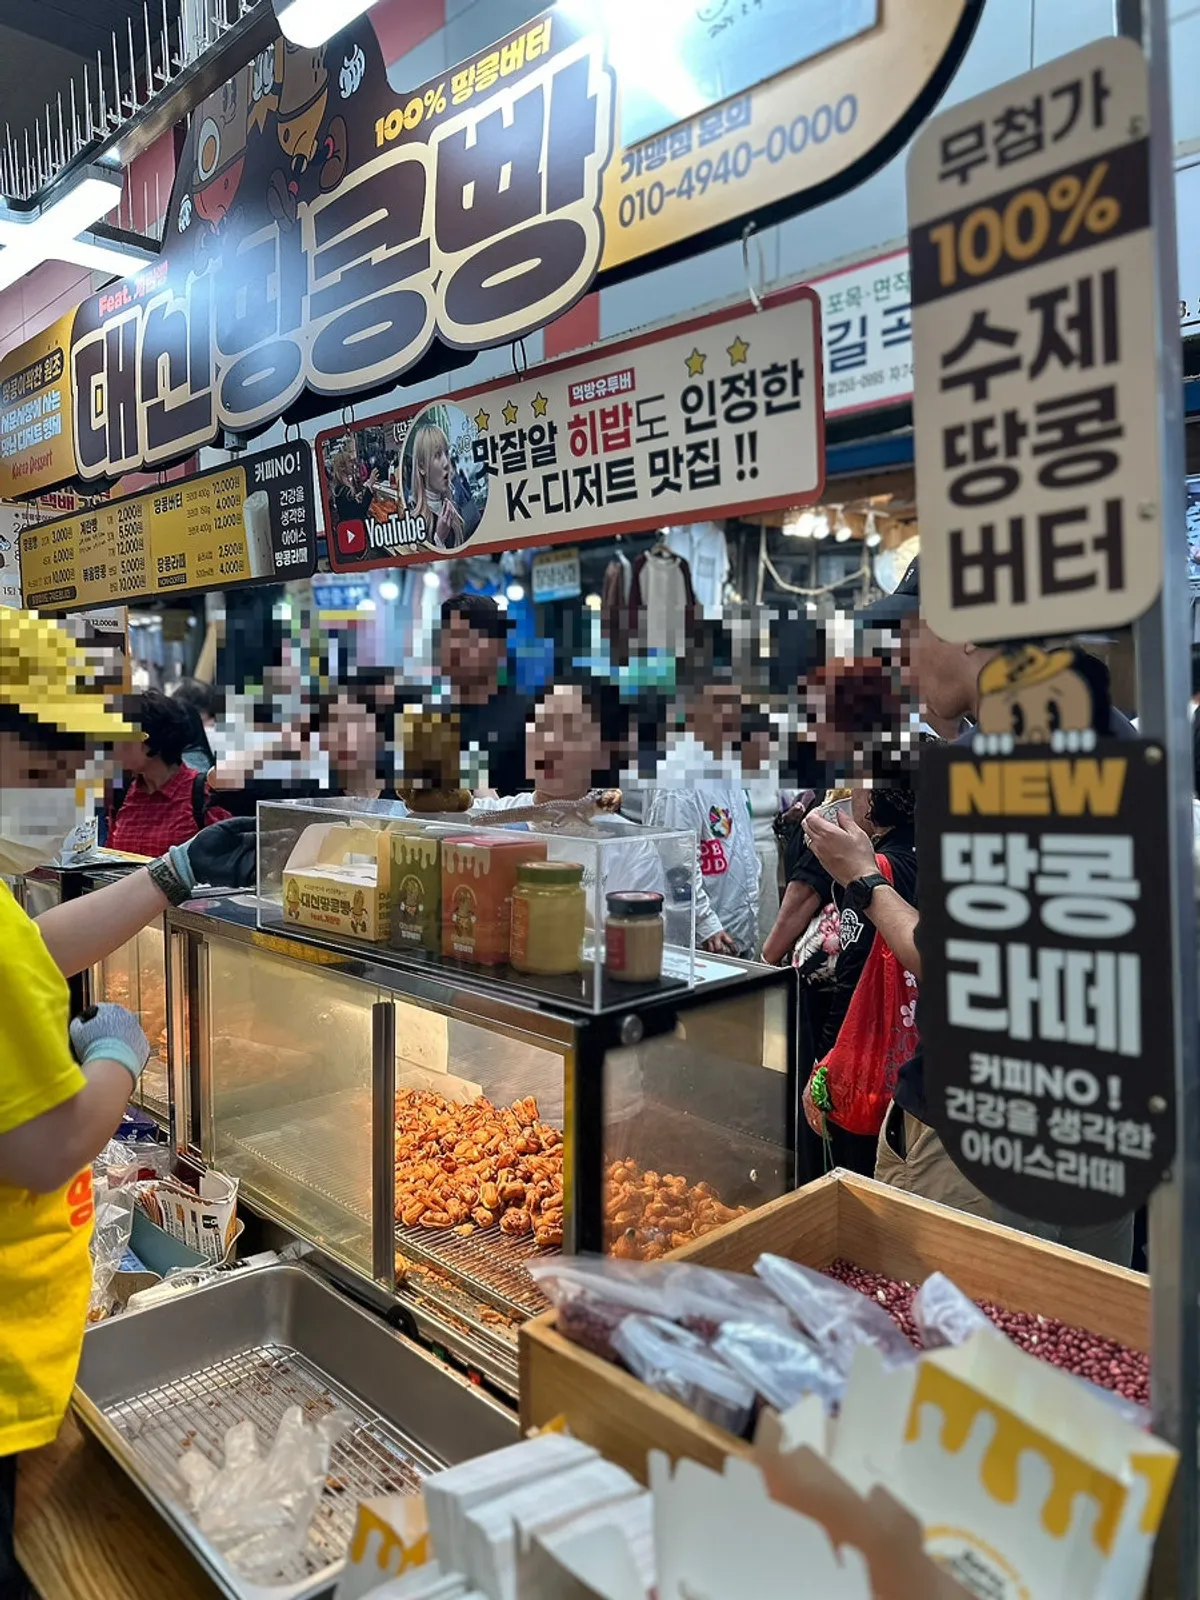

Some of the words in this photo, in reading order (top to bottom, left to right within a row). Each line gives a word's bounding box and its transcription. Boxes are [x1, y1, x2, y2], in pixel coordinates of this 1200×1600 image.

[375, 83, 446, 147] 100%
[451, 17, 552, 105] 땅콩버터
[621, 124, 693, 183] 가맹점
[698, 94, 752, 148] 문의
[938, 69, 1111, 186] 무첨가
[618, 93, 858, 228] 010-4940-0000
[929, 161, 1121, 287] 100%
[74, 50, 602, 470] 대신땅콩빵
[98, 285, 132, 318] Feat.
[940, 268, 1122, 404] 수제
[44, 353, 61, 383] 원조
[572, 373, 633, 402] 먹방유투버
[472, 420, 557, 476] 맛잘알
[567, 394, 669, 457] 히밥도
[680, 358, 804, 434] 인정한
[940, 383, 1124, 508] 땅콩
[255, 450, 301, 483] 커피NO!
[506, 456, 638, 522] K-디저트
[649, 437, 721, 498] 맛집
[153, 491, 182, 514] 땅콩버터
[216, 494, 241, 511] 4,000원
[279, 485, 305, 507] 건강을
[119, 521, 143, 539] 5,500원
[214, 514, 242, 530] 12,000원
[280, 507, 306, 526] 생각한
[365, 511, 426, 548] YouTube
[117, 538, 144, 556] 12,000원
[281, 527, 307, 546] 아이스
[120, 557, 145, 574] 5,000원
[157, 553, 186, 573] 땅콩라떼
[218, 543, 243, 559] 2,500원
[219, 560, 244, 575] 4,000원
[275, 547, 308, 568] 땅콩라떼
[947, 499, 1127, 610] 버터
[119, 575, 146, 591] 10,000원
[948, 758, 1128, 816] NEW
[940, 831, 1142, 939] 땅콩
[300, 892, 352, 917] 대신땅콩빵
[944, 938, 1144, 1057] 라떼
[969, 1051, 1101, 1106] 커피NO
[945, 1086, 1040, 1137] 건강을
[1046, 1107, 1156, 1161] 생각한
[960, 1129, 1126, 1198] 아이스라떼
